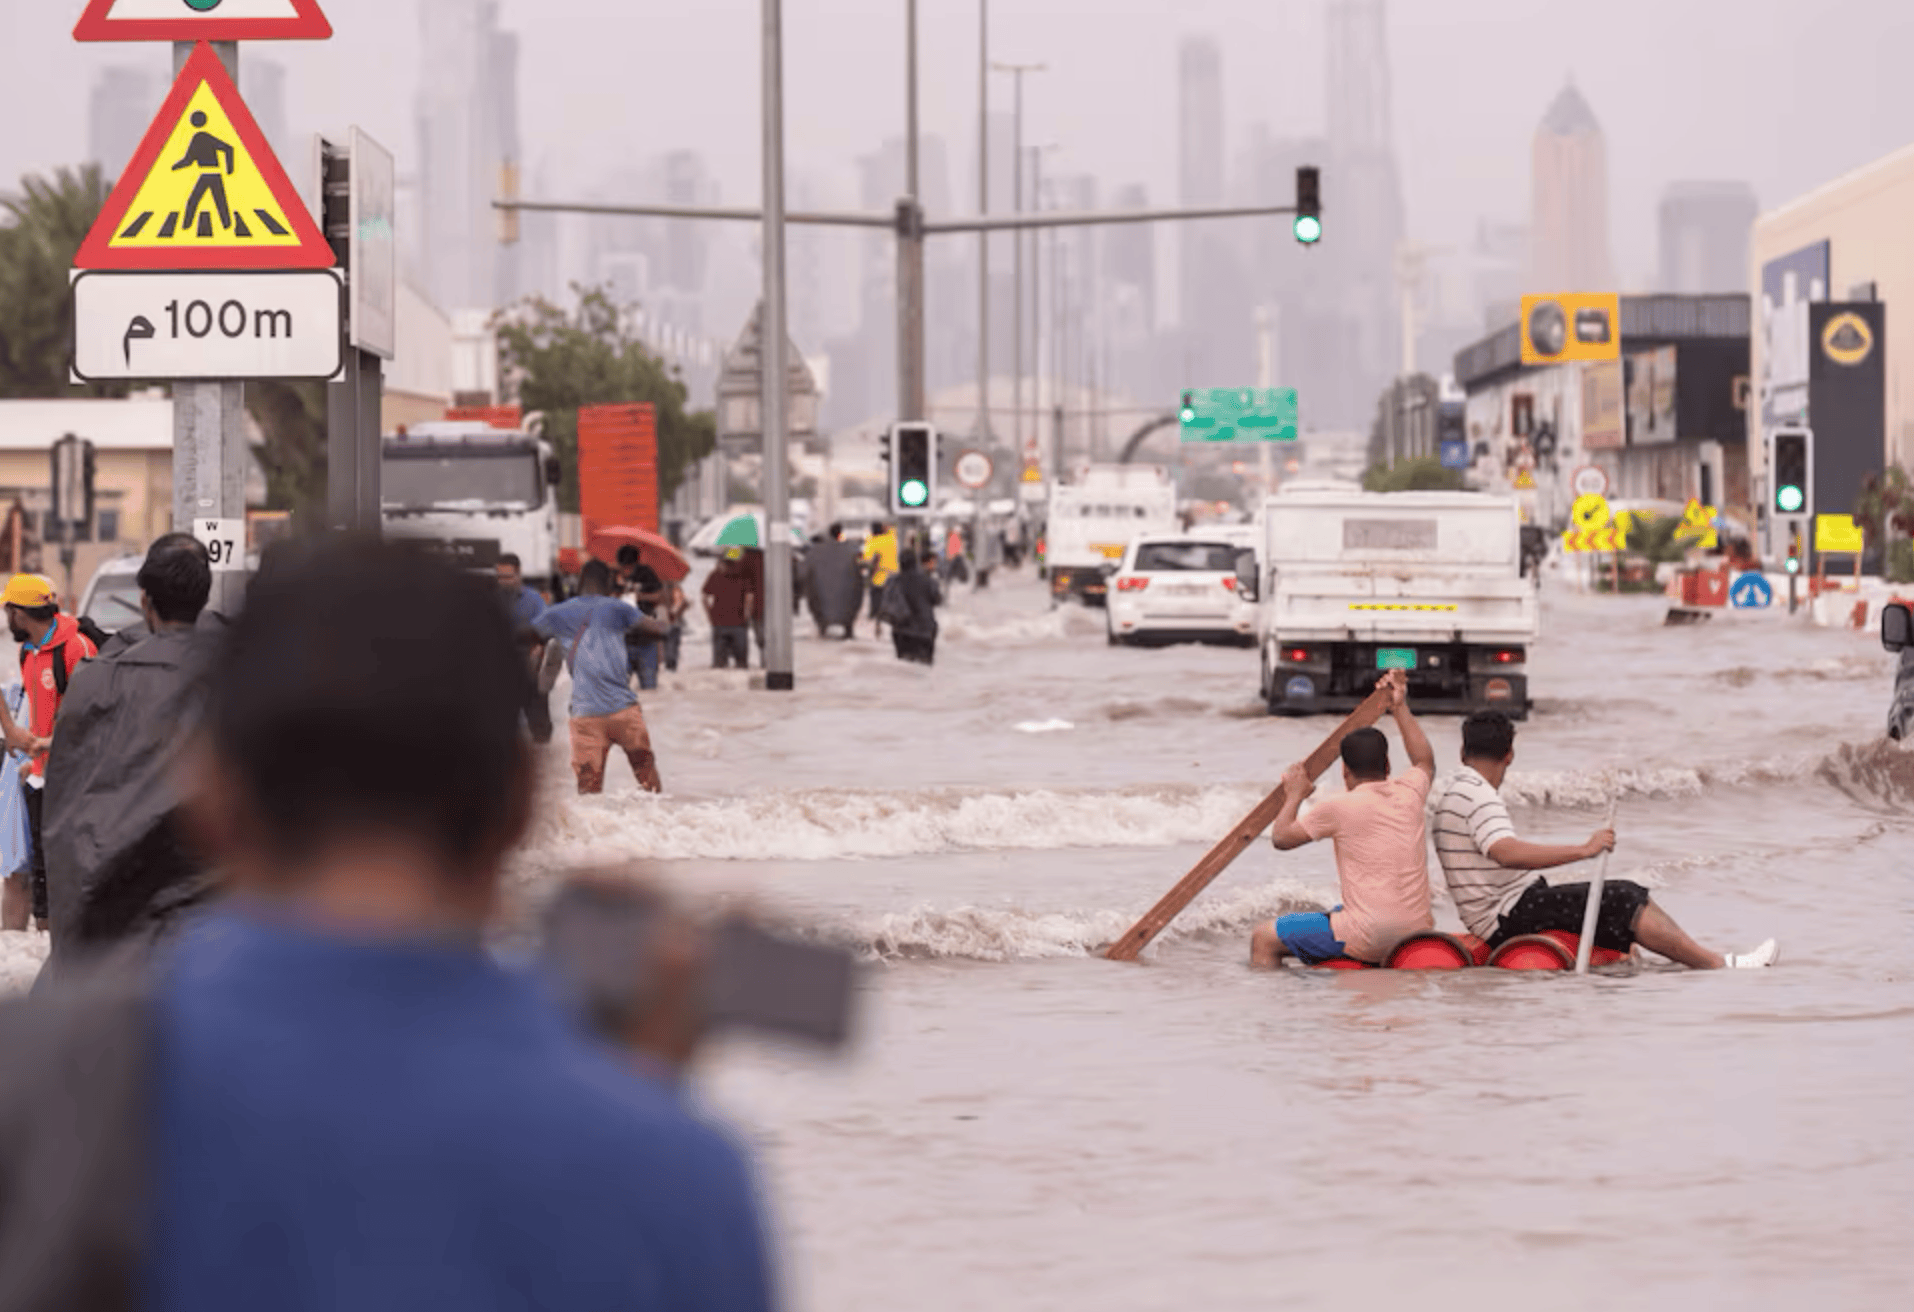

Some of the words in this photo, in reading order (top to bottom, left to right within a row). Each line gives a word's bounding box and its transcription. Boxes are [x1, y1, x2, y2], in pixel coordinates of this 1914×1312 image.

[123, 315, 156, 370] م
[165, 299, 292, 339] 100m
[205, 521, 219, 532] W
